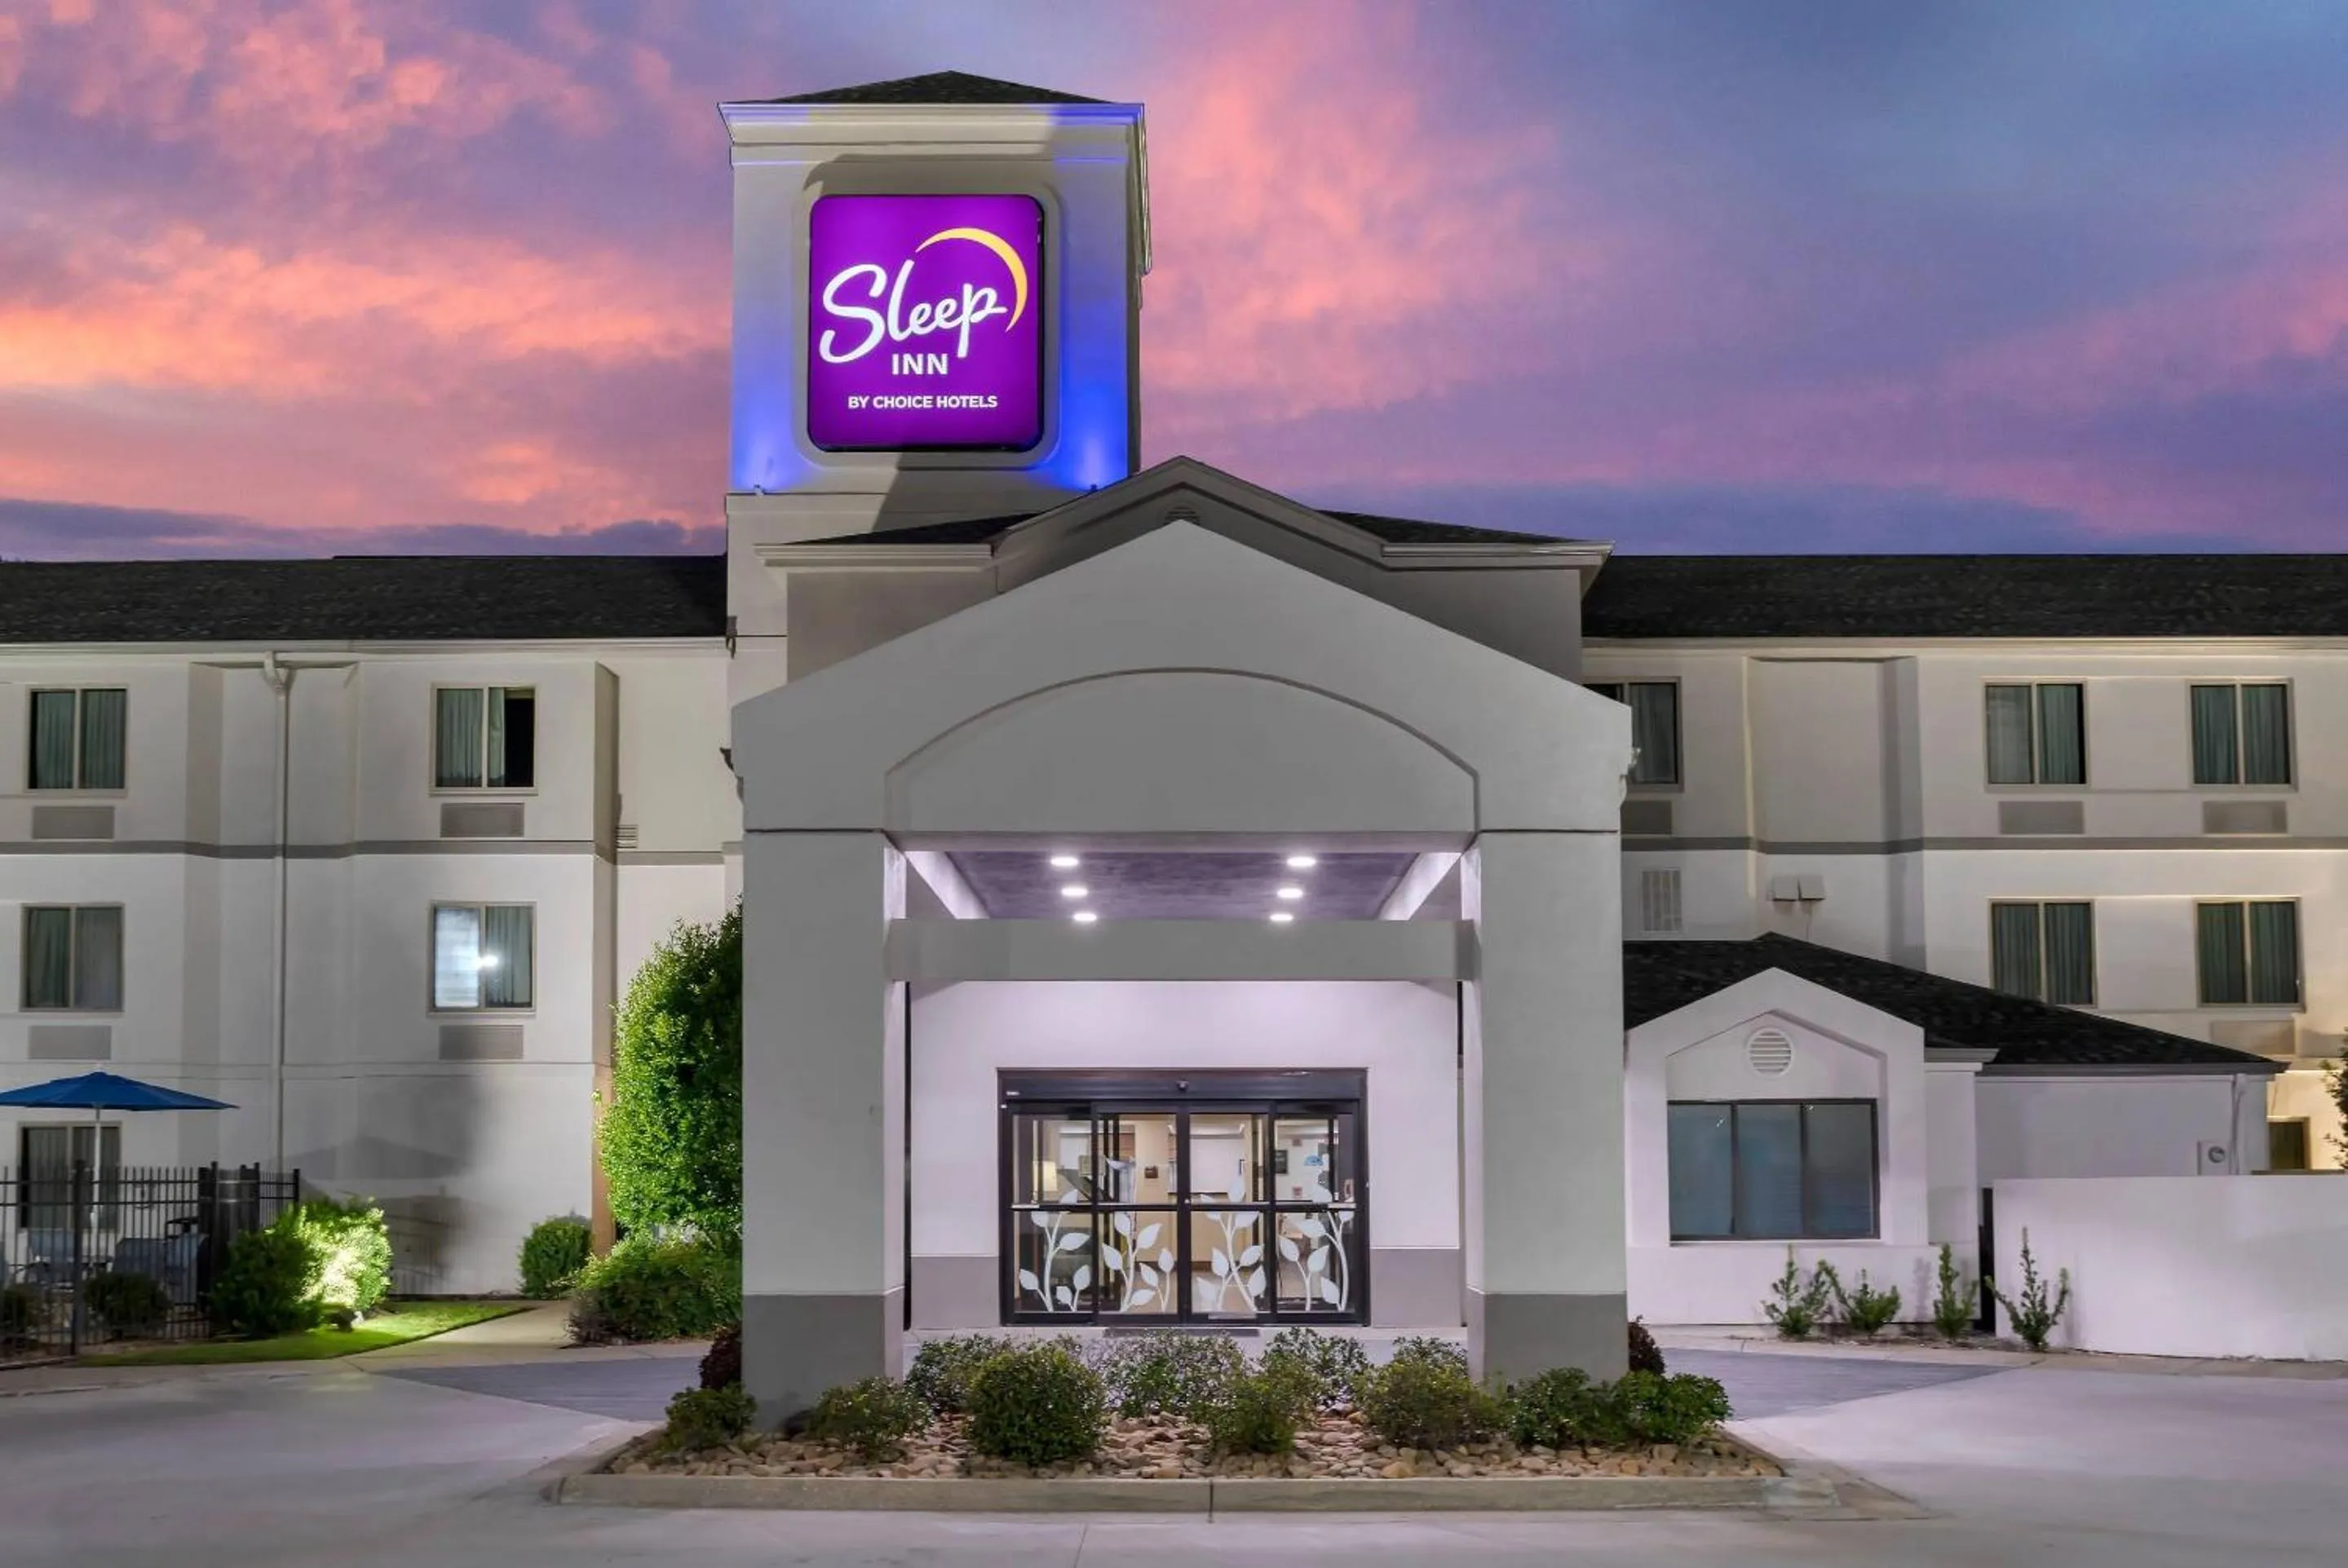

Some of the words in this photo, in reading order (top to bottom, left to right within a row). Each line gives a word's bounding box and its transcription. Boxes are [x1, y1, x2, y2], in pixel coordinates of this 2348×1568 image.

[819, 259, 1008, 364] Sleep
[891, 353, 948, 375] INN
[847, 395, 870, 409] BY
[872, 395, 934, 409] CHOICE
[935, 395, 998, 409] HOTELS
